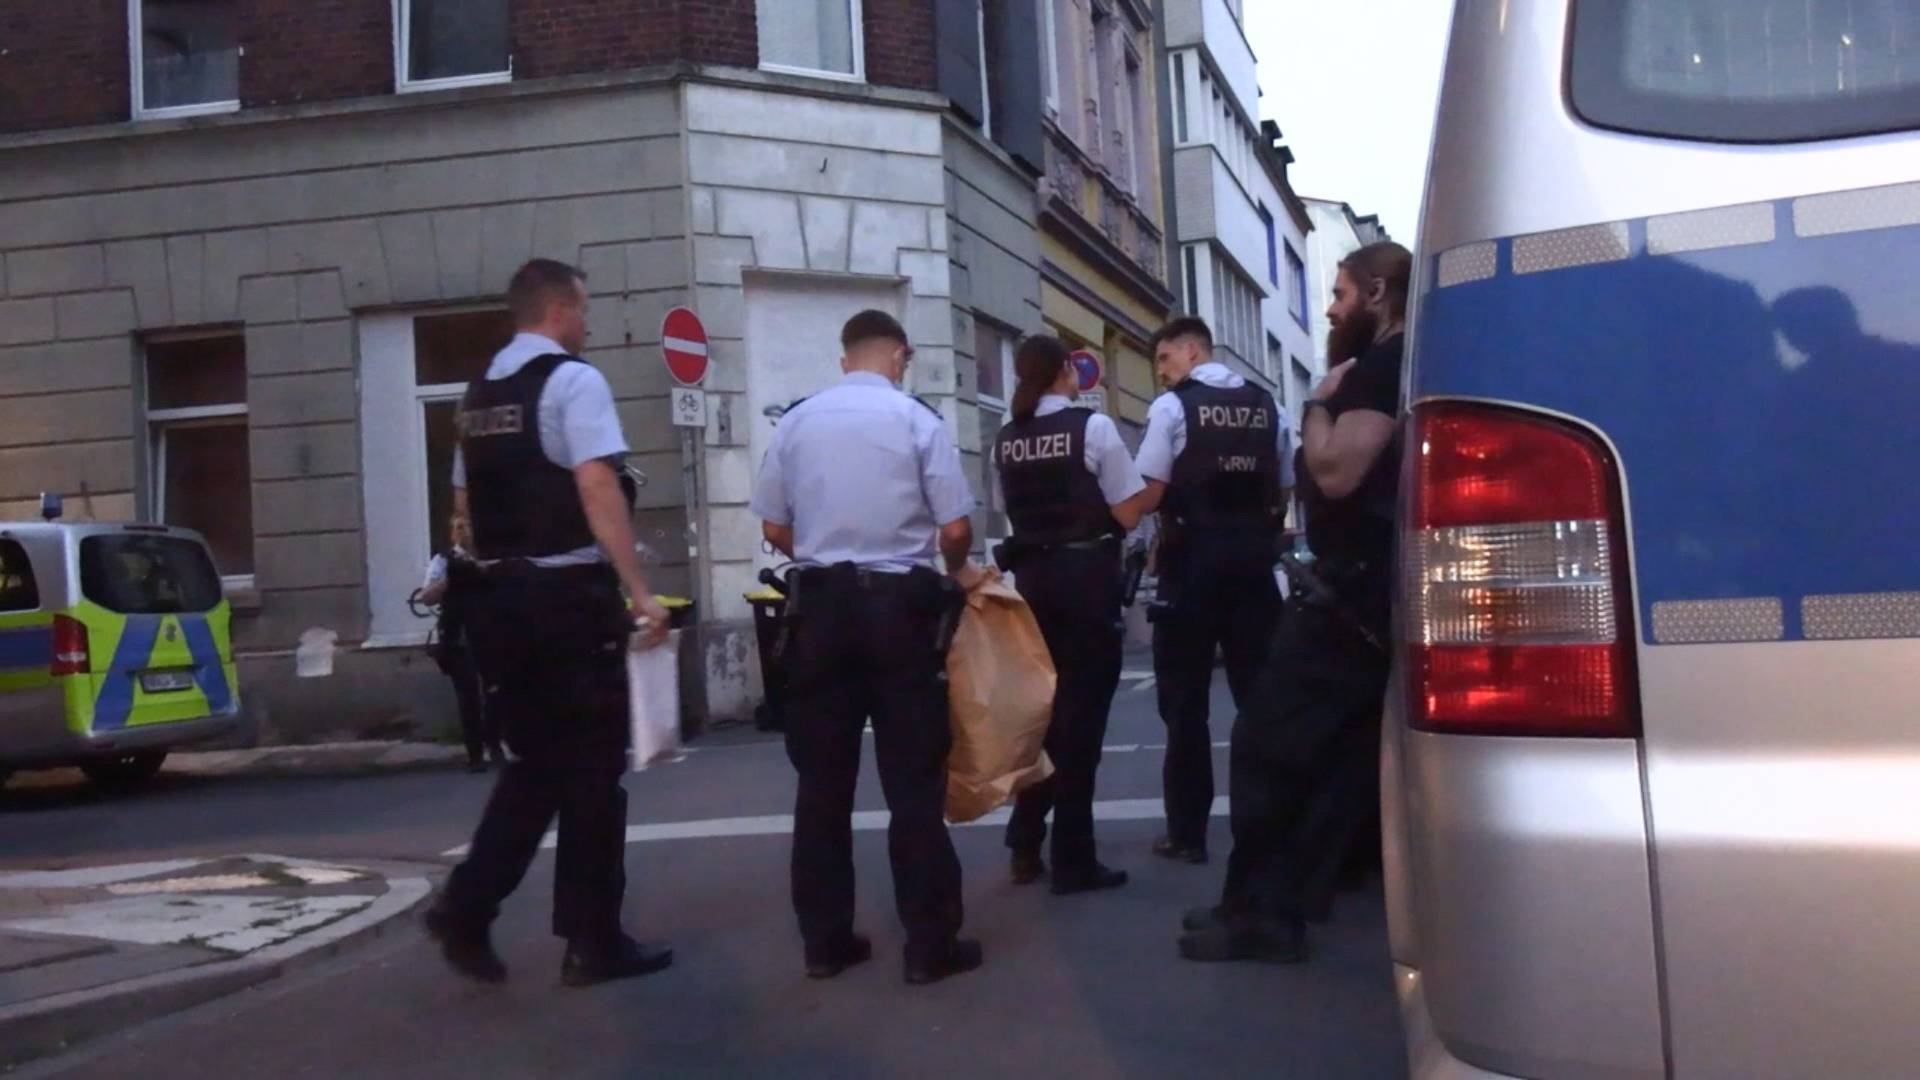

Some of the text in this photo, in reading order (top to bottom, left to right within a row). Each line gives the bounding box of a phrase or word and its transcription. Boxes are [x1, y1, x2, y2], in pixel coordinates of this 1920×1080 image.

[457, 404, 523, 436] LIZEI
[1198, 405, 1269, 429] POLIZEI
[1001, 432, 1071, 464] POLIZEI
